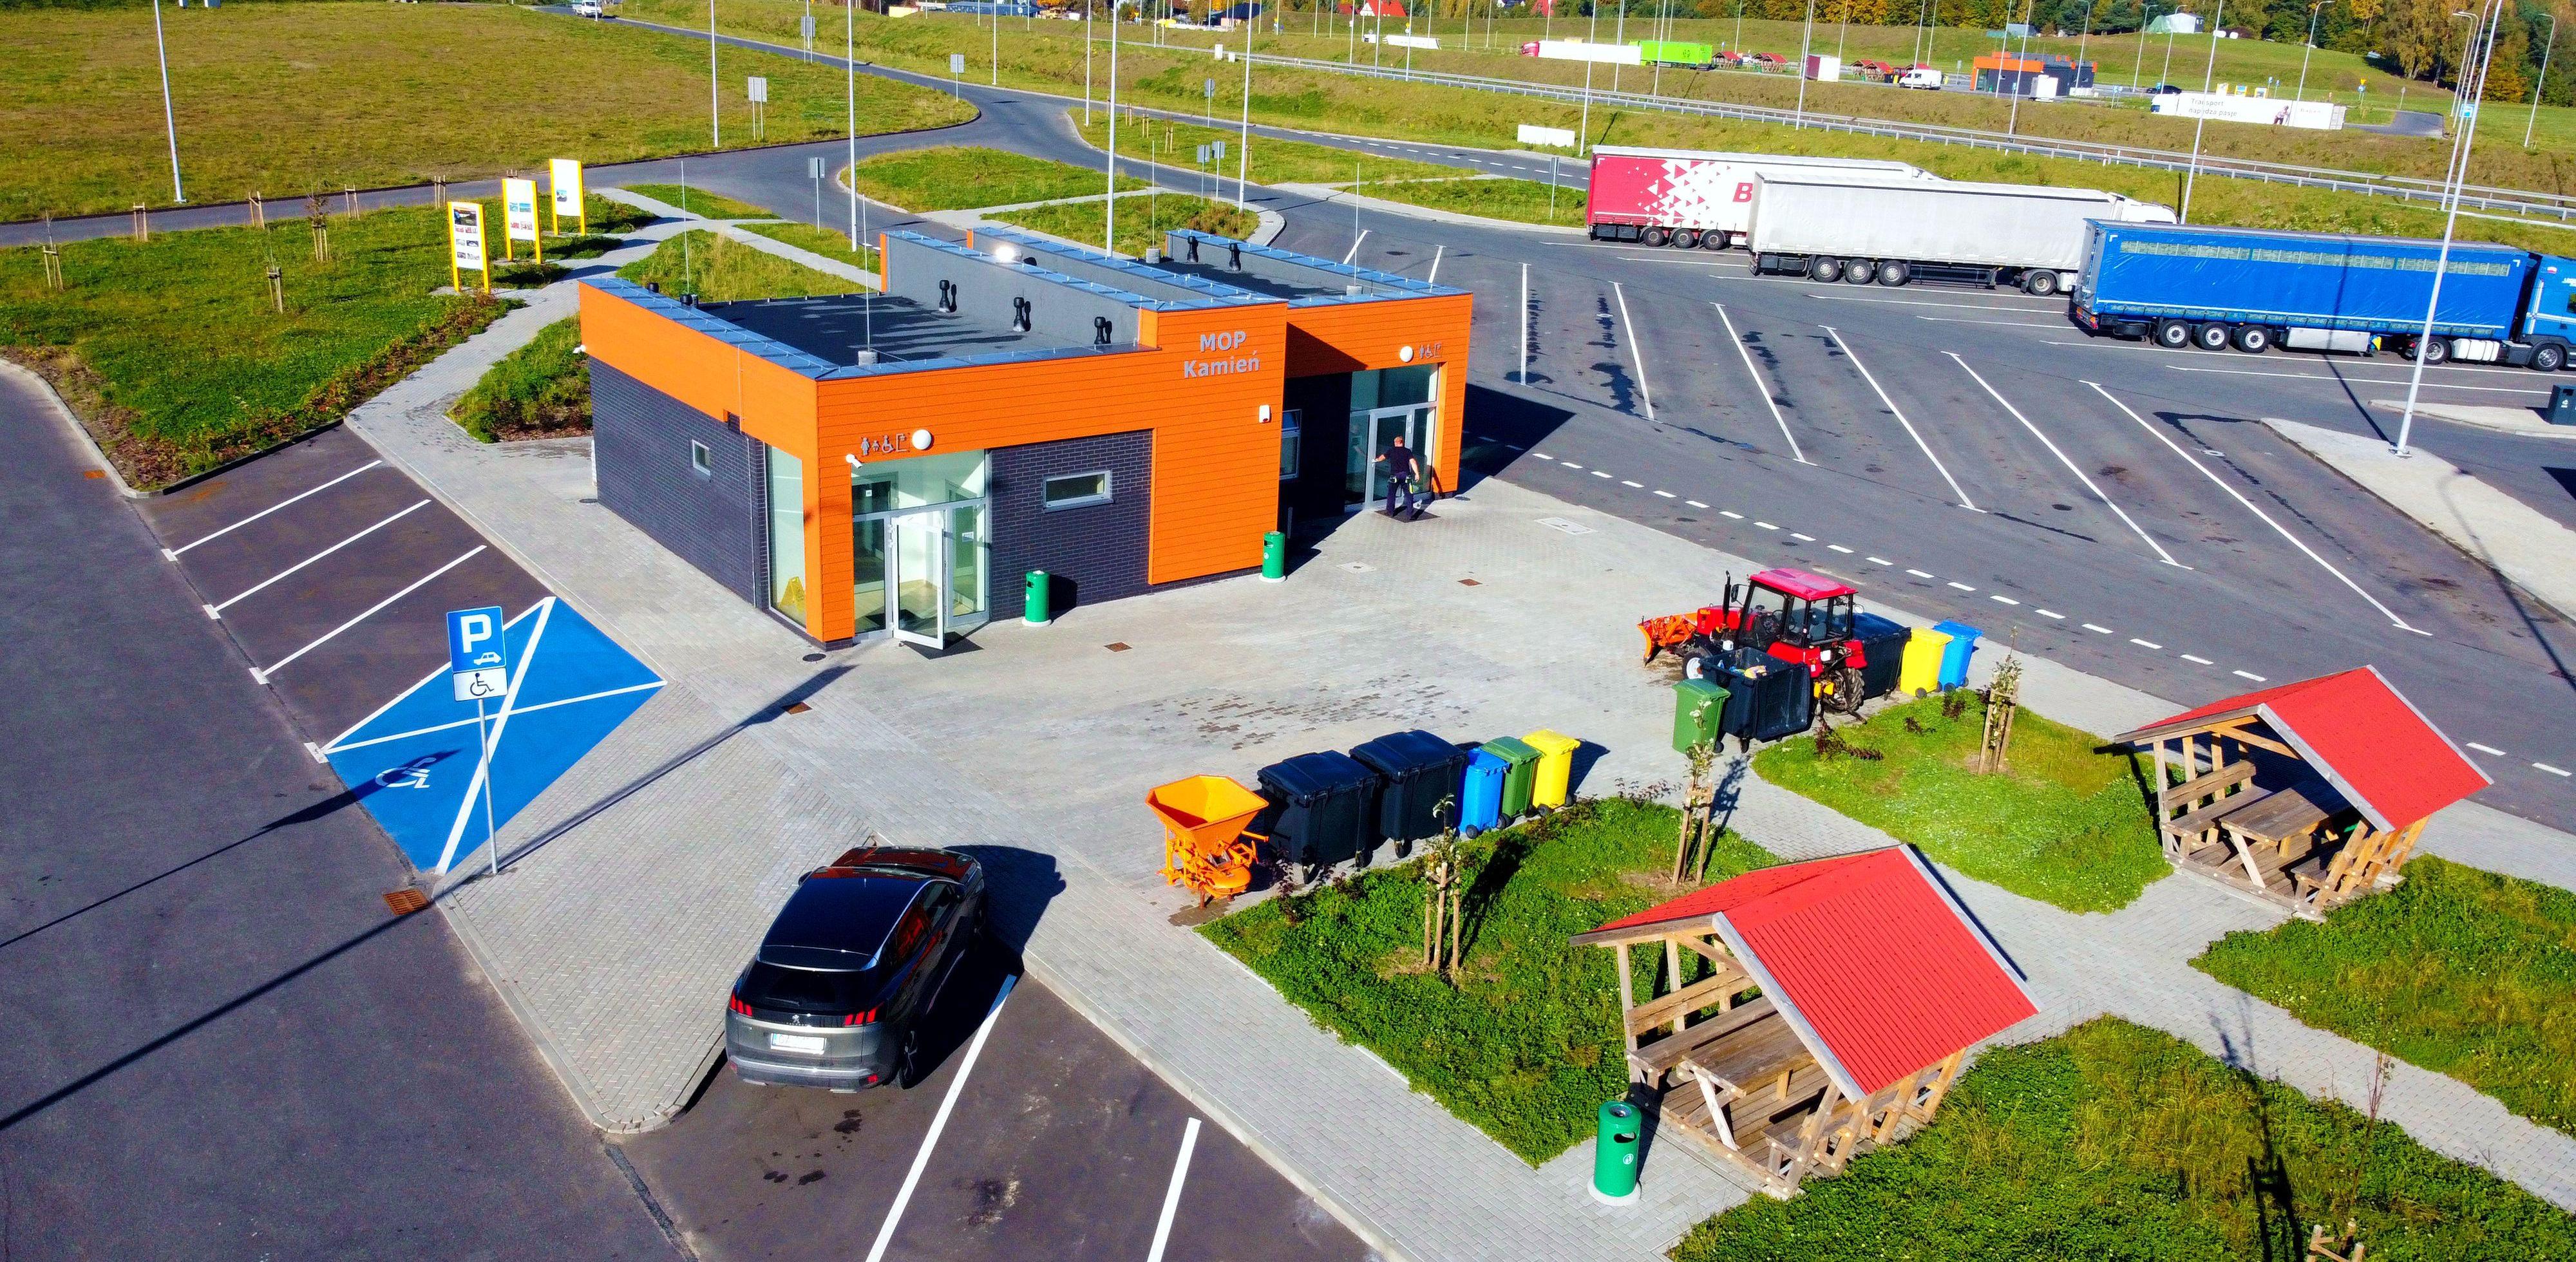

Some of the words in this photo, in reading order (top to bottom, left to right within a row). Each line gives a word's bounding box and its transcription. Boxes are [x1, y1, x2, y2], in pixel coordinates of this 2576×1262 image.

[1200, 330, 1247, 353] MOP
[1184, 350, 1260, 379] Kamień
[460, 614, 492, 654] P
